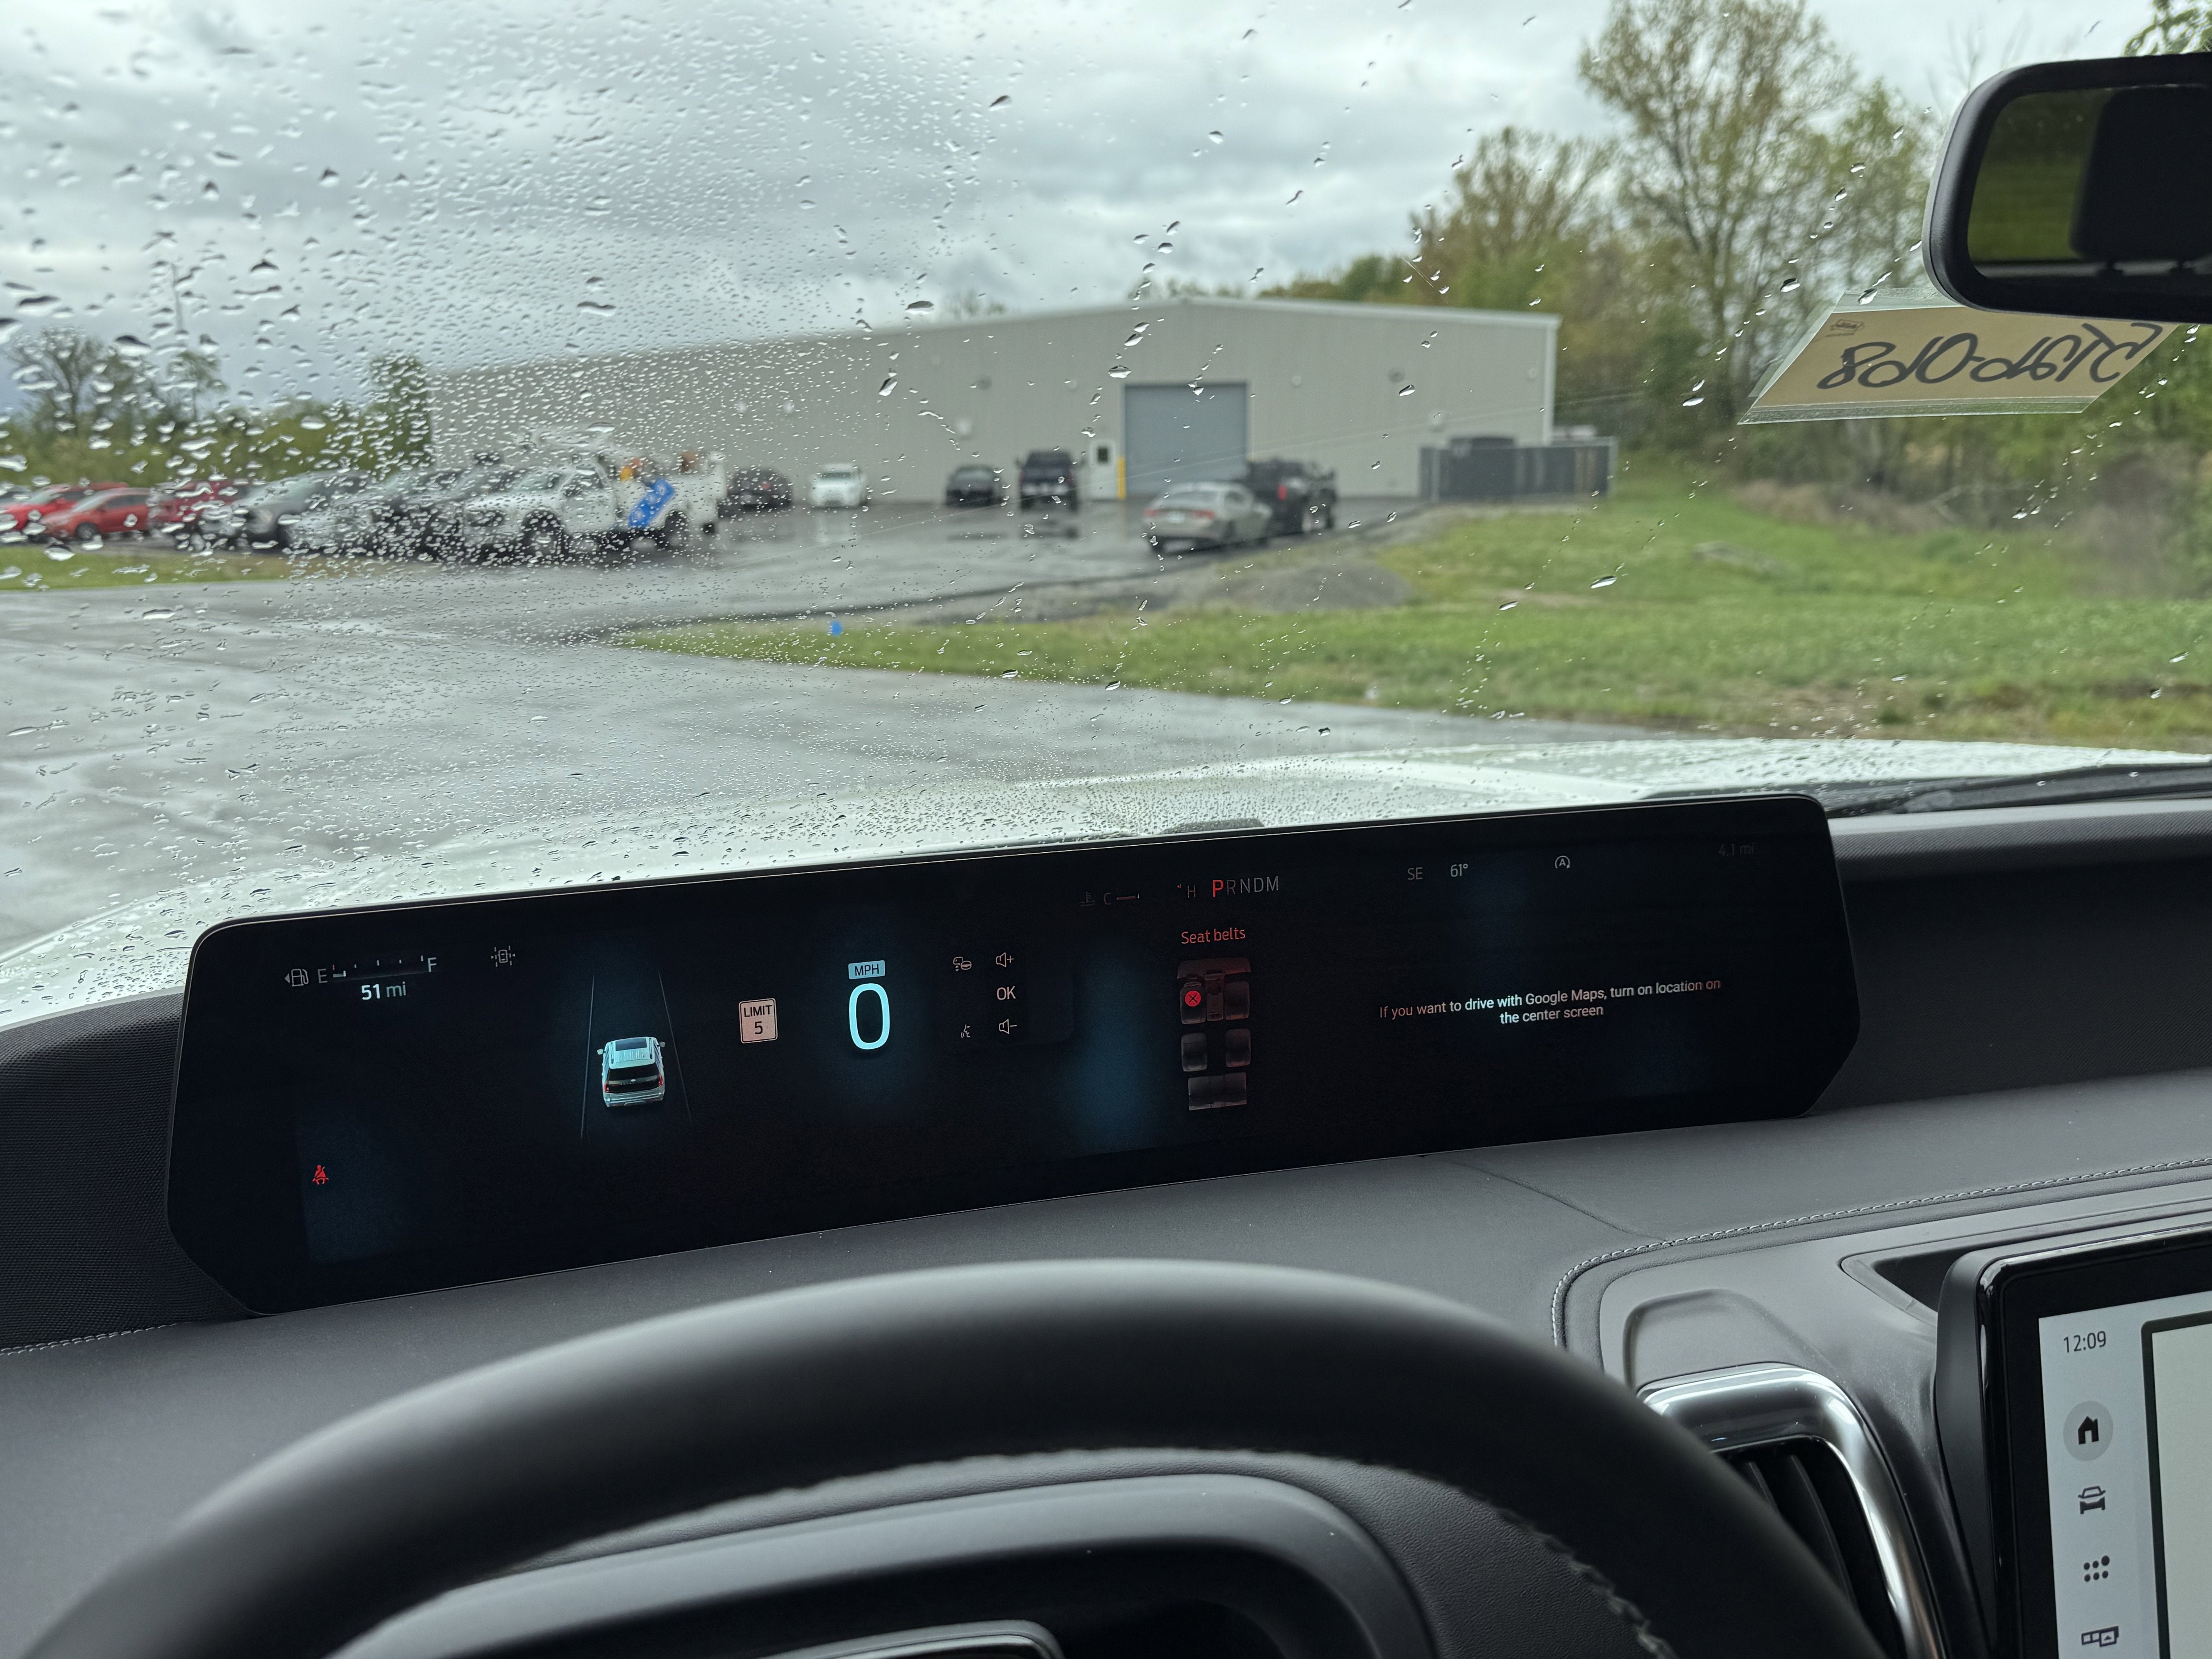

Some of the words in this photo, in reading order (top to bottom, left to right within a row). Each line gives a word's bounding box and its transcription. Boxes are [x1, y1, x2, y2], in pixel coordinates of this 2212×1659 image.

[1407, 867, 1423, 880] SE
[1450, 863, 1468, 878] 61°
[1104, 892, 1111, 905] C
[1187, 885, 1196, 898] H
[1181, 930, 1211, 945] Seat
[1214, 927, 1246, 941] belts
[428, 957, 437, 972] F
[855, 964, 879, 976] MPH
[318, 969, 328, 984] E
[361, 984, 381, 1001] 51
[386, 981, 407, 998] mi
[996, 986, 1016, 1000] OK
[1380, 1006, 1388, 1018] If
[1392, 1007, 1413, 1020] you
[1417, 1002, 1446, 1015] want
[1449, 1001, 1462, 1012] to
[1465, 998, 1494, 1011] drive
[1497, 994, 1522, 1008] with
[1525, 990, 1568, 1006] Google
[1571, 989, 1607, 1002] Maps,
[1610, 986, 1635, 998] turn
[1637, 984, 1653, 995] on
[1656, 980, 1703, 994] location
[1706, 979, 1721, 990] on
[744, 1005, 773, 1018] LIMIT
[848, 983, 890, 1050] 0
[1499, 1012, 1520, 1024] the
[1522, 1009, 1561, 1023] center
[1563, 1006, 1604, 1018] screen
[754, 1021, 763, 1035] 5
[2063, 1330, 2107, 1353] 12:09
